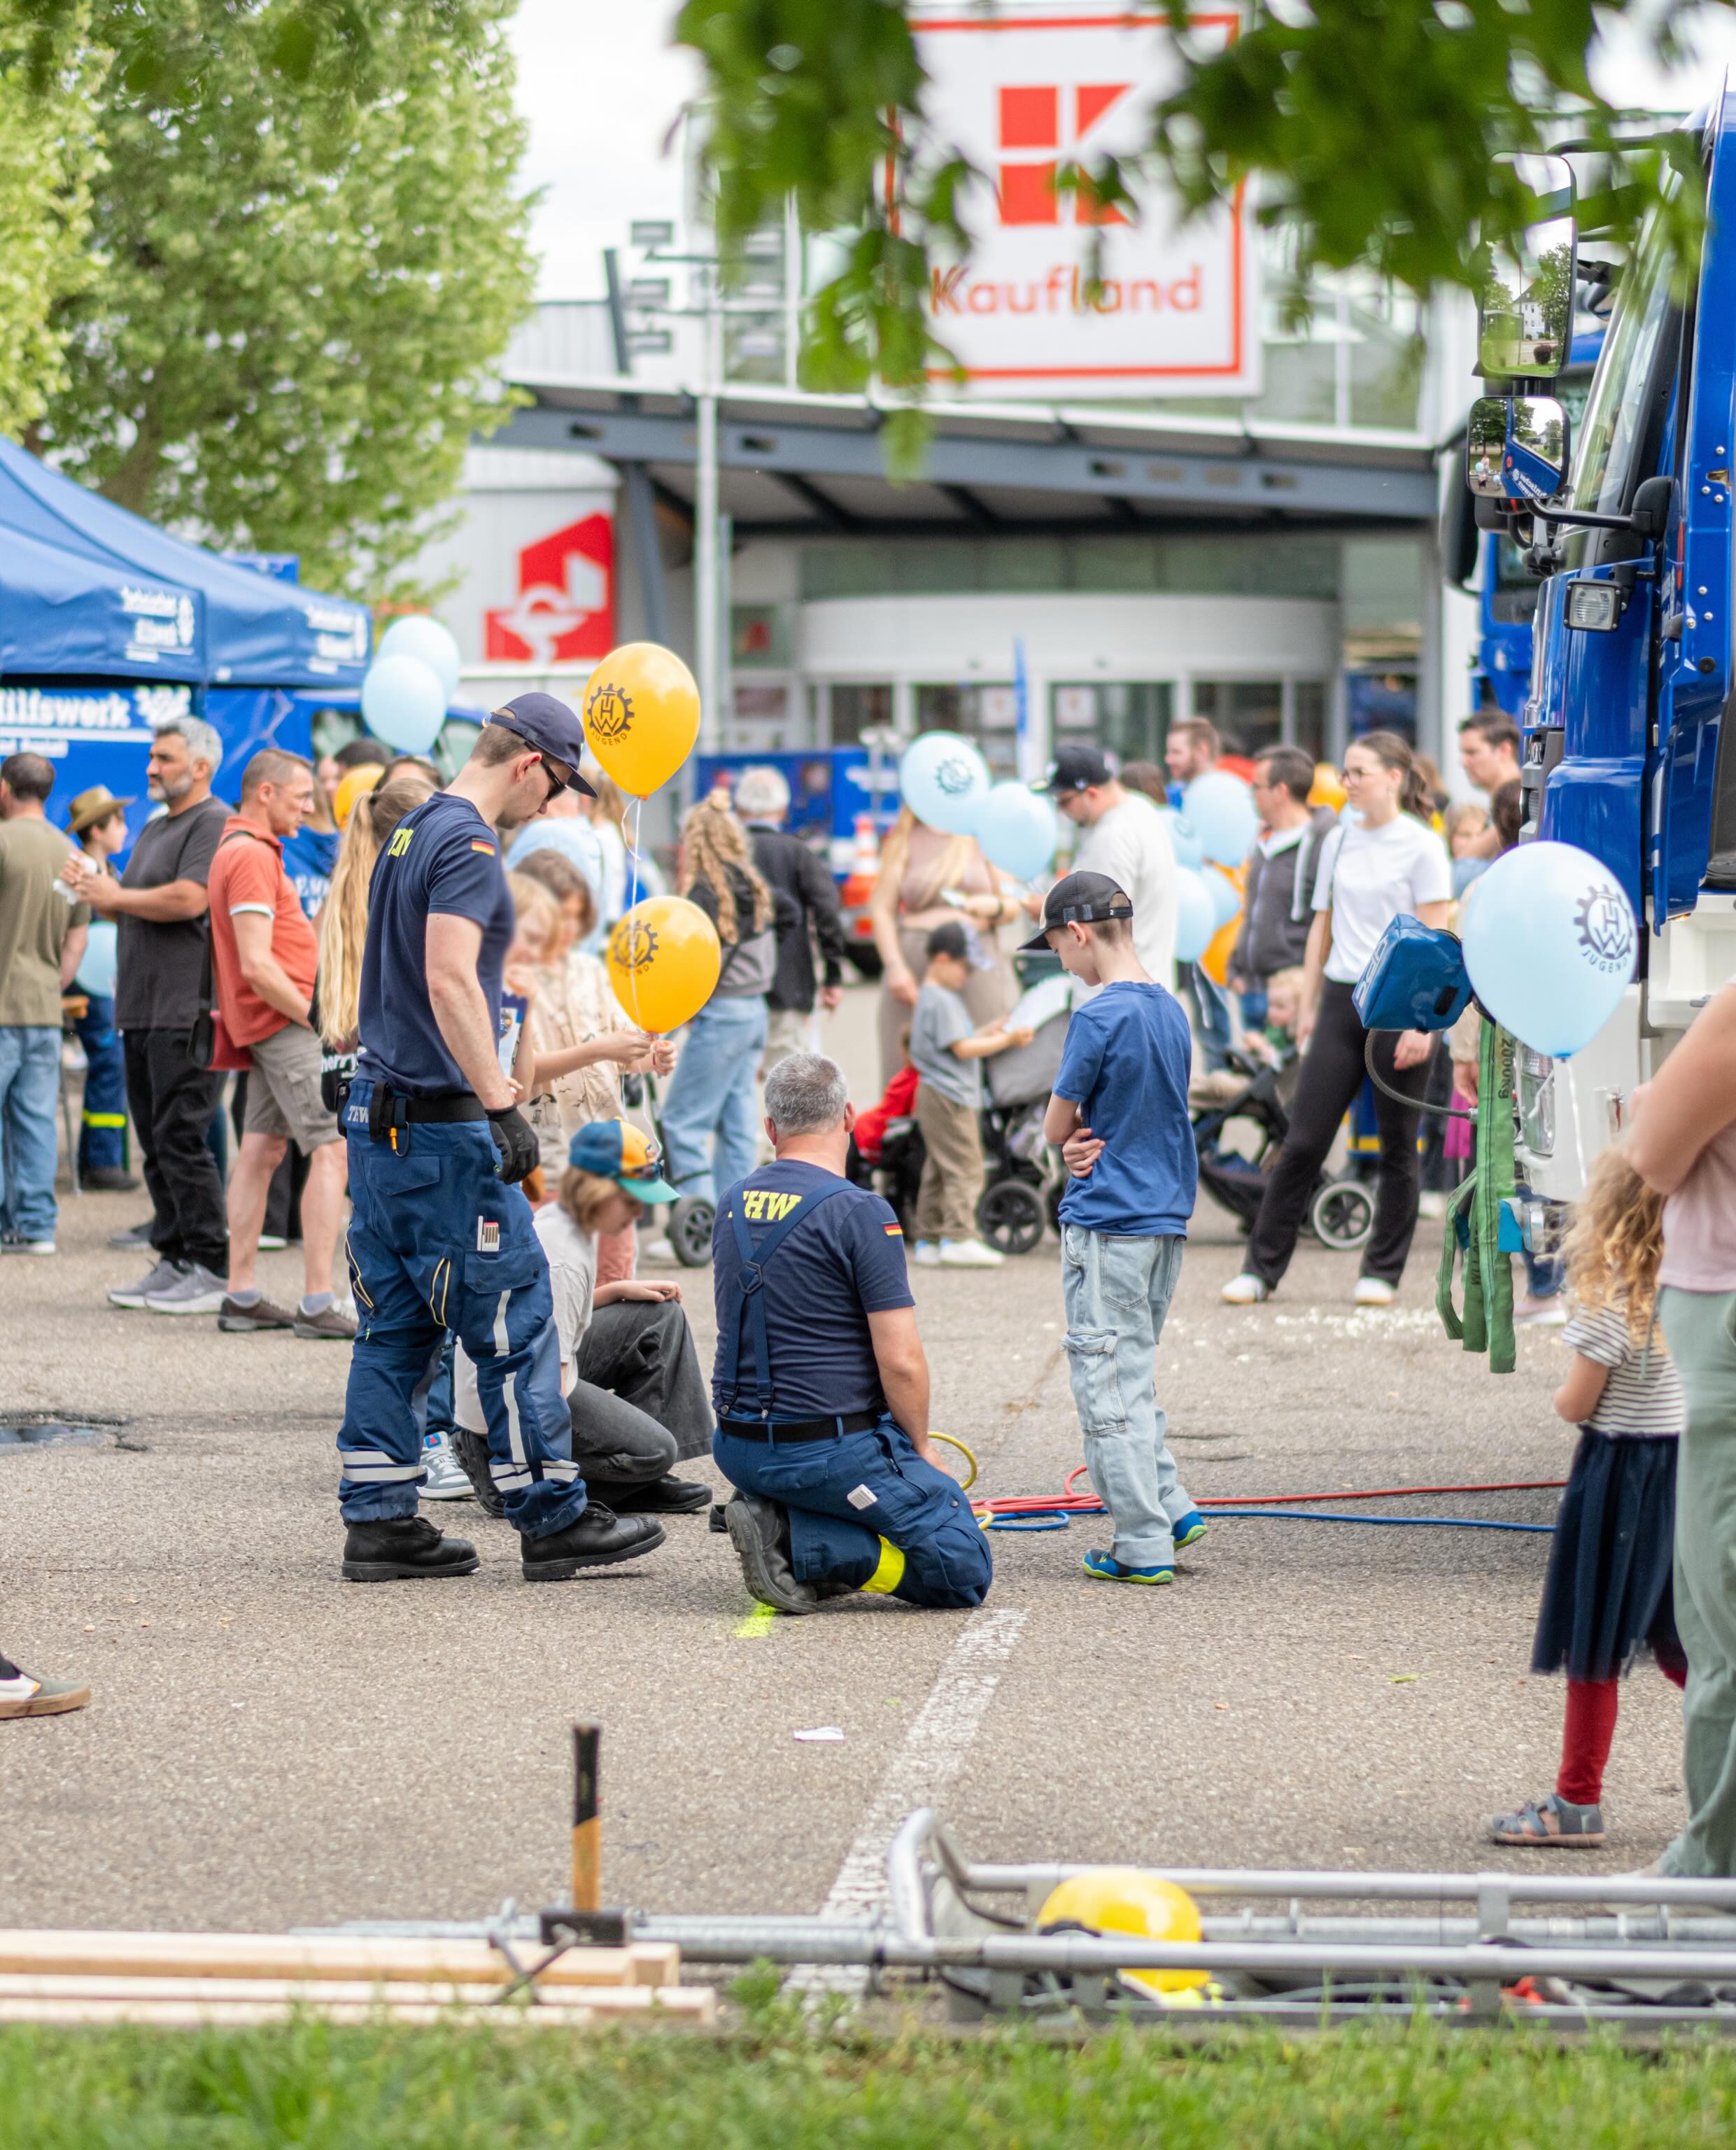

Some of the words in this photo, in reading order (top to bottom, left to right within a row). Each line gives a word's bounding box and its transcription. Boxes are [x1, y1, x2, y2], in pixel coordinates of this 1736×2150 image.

[931, 264, 1201, 315] Kaufland
[591, 731, 627, 746] JUGEND
[1581, 949, 1628, 974] JUGEND
